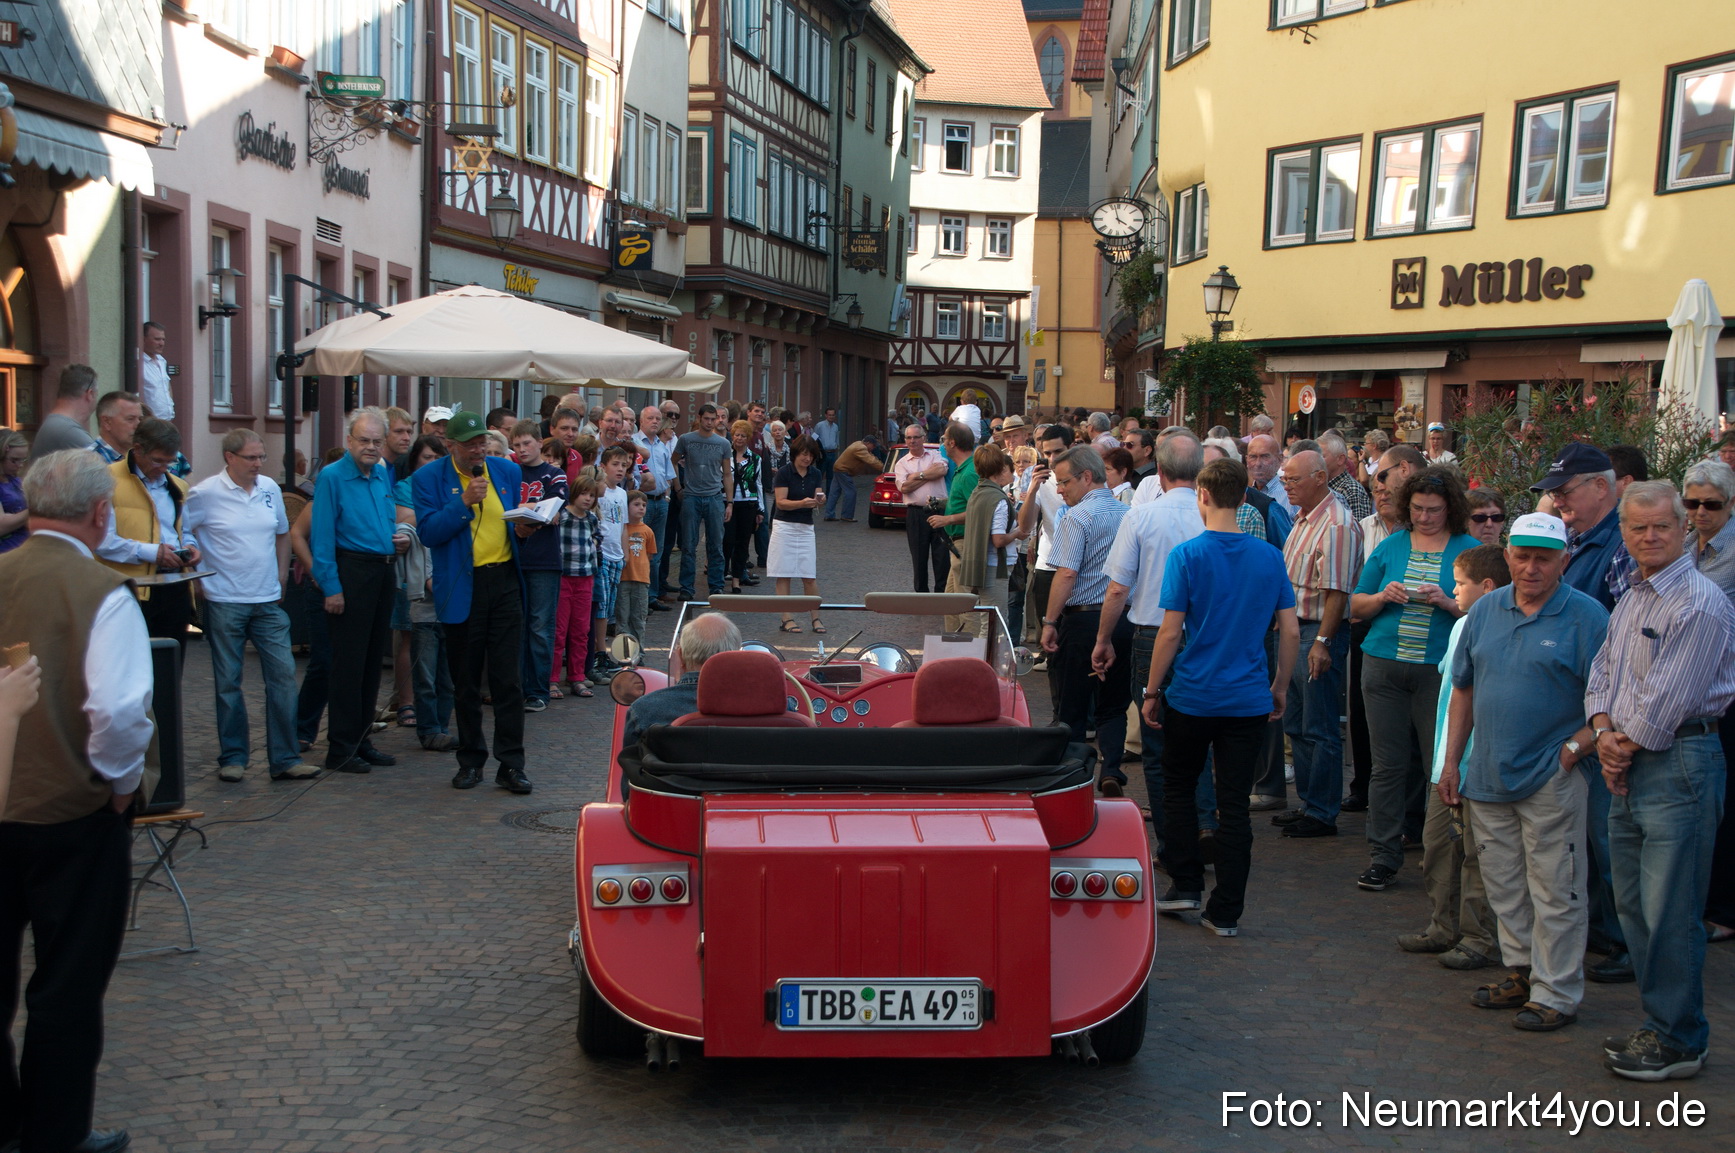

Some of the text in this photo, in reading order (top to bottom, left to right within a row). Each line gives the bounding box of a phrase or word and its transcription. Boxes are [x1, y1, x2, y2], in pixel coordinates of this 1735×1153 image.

[850, 244, 879, 254] Schäfer
[1103, 242, 1137, 251] JUWELIER
[1112, 250, 1131, 264] JAN
[503, 263, 540, 296] Tchibo
[1438, 257, 1594, 308] Müller
[786, 990, 975, 1021] D TBB EA 49 05
[962, 1011, 975, 1020] 10
